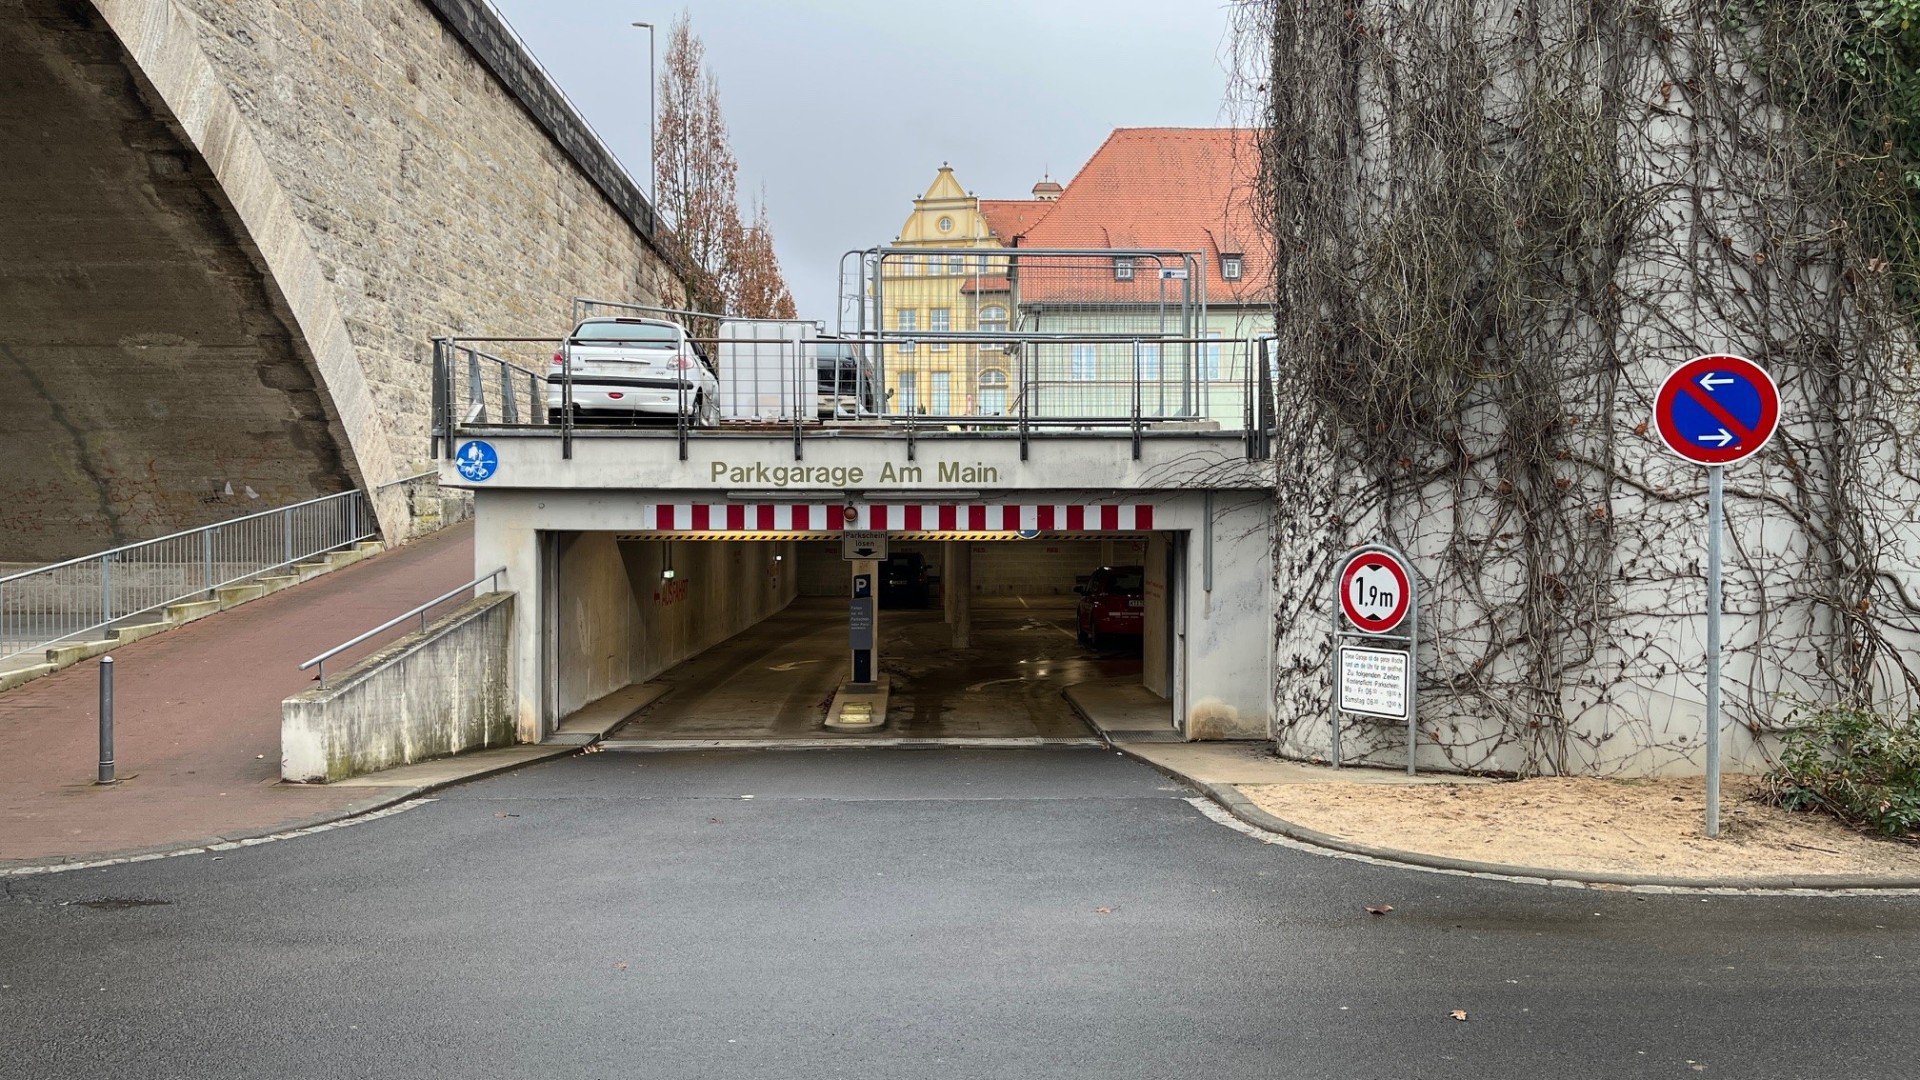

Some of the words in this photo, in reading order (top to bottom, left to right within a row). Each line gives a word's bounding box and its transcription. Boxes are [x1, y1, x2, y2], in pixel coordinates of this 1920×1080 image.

[711, 461, 864, 487] Parkgarage
[879, 461, 922, 483] Am
[938, 461, 998, 483] Main
[856, 578, 867, 592] P
[1356, 670, 1381, 679] folgenden
[1383, 672, 1400, 680] Zeiten
[1345, 685, 1352, 693] Mo
[1344, 695, 1365, 705] Samstag
